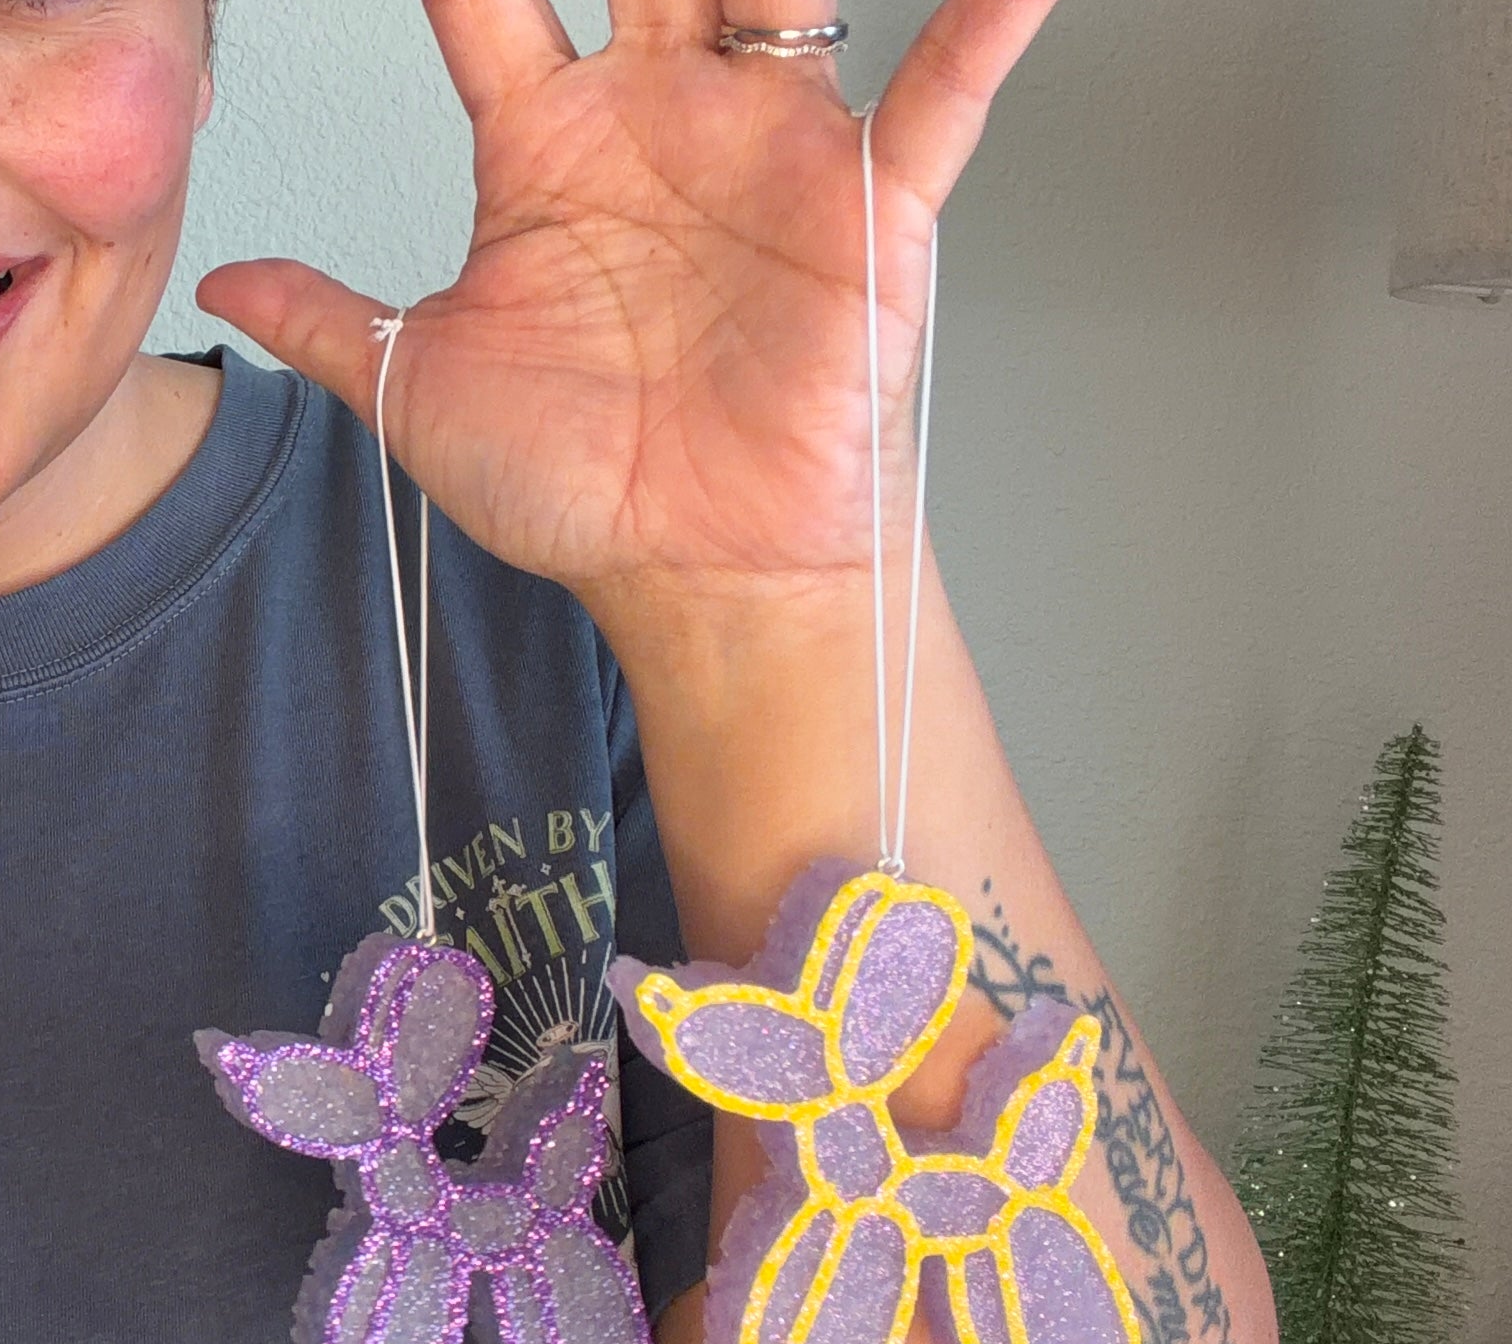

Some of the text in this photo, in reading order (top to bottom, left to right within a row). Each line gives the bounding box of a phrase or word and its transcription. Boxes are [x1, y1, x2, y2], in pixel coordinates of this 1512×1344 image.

[379, 809, 611, 939] DRIVEN BY
[436, 859, 616, 987] AITH
